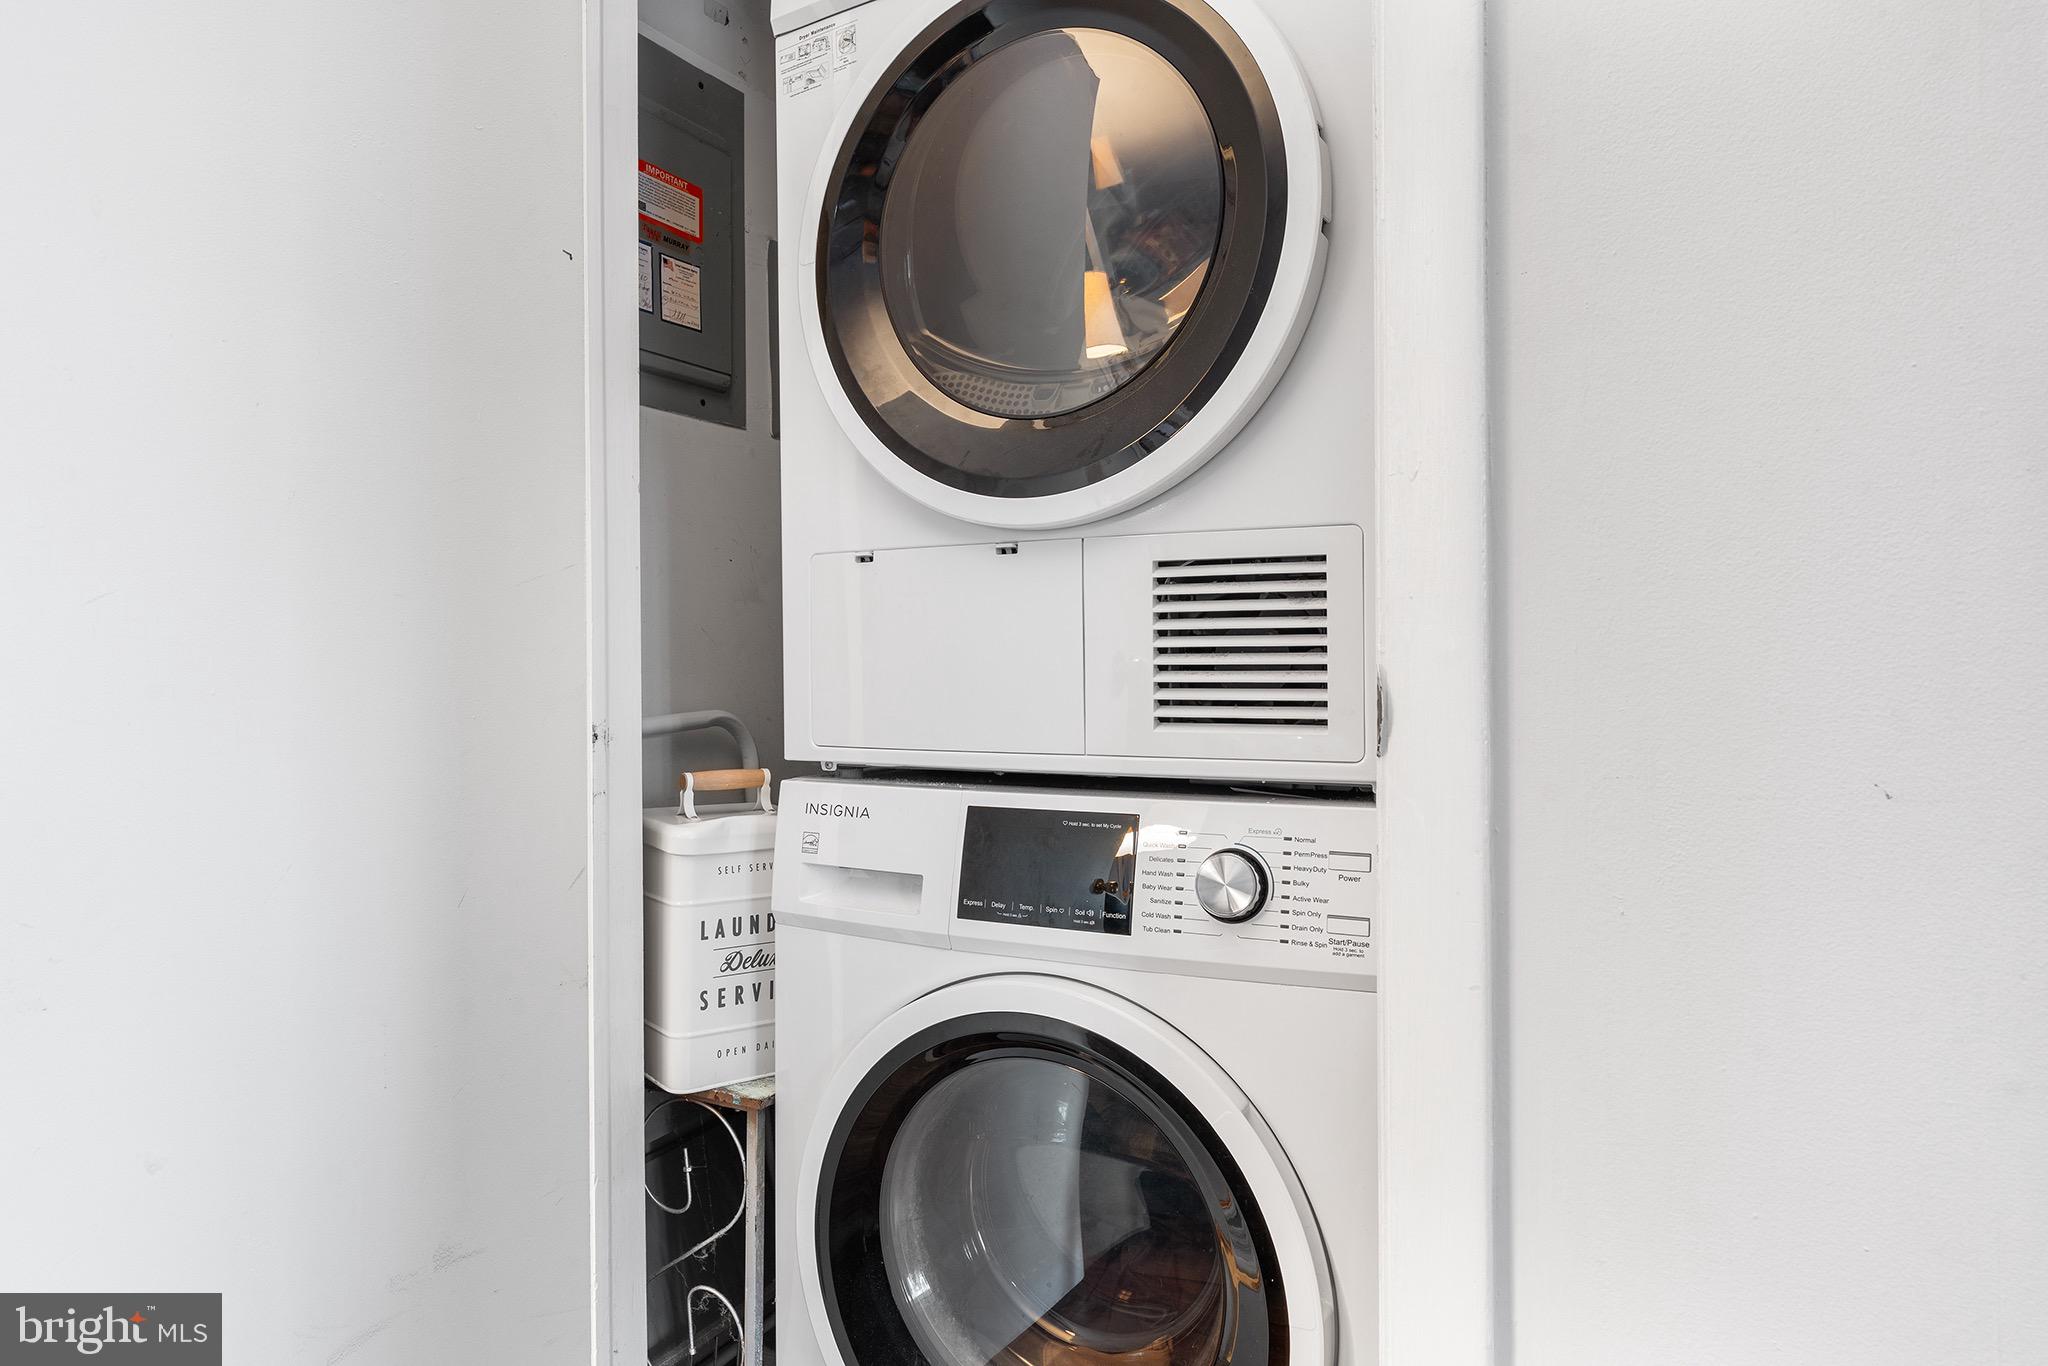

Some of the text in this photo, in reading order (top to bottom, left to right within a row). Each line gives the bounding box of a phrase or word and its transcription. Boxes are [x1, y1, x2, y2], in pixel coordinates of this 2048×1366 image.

[645, 163, 688, 190] IMPORTANT
[663, 235, 689, 251] MURRAY
[804, 802, 870, 819] INSIGNIA
[1248, 828, 1271, 836] Express
[718, 864, 742, 875] SELF
[1338, 874, 1361, 883] Power
[1142, 883, 1156, 891] Baby
[963, 899, 983, 907] Express
[1150, 897, 1172, 905] Sanitize
[1293, 895, 1329, 904] Active Wear
[991, 901, 1006, 910] Delay
[1045, 906, 1058, 914] Spin
[1074, 908, 1085, 916] Soil
[1102, 911, 1126, 920] Function
[1292, 910, 1322, 919] Spin Only
[700, 913, 775, 941] LAUND
[1154, 926, 1171, 934] Clean
[1309, 926, 1324, 934] Only
[1328, 937, 1370, 949] Start/Pause
[700, 980, 774, 1011] SERVI
[717, 1046, 746, 1058] OPEN
